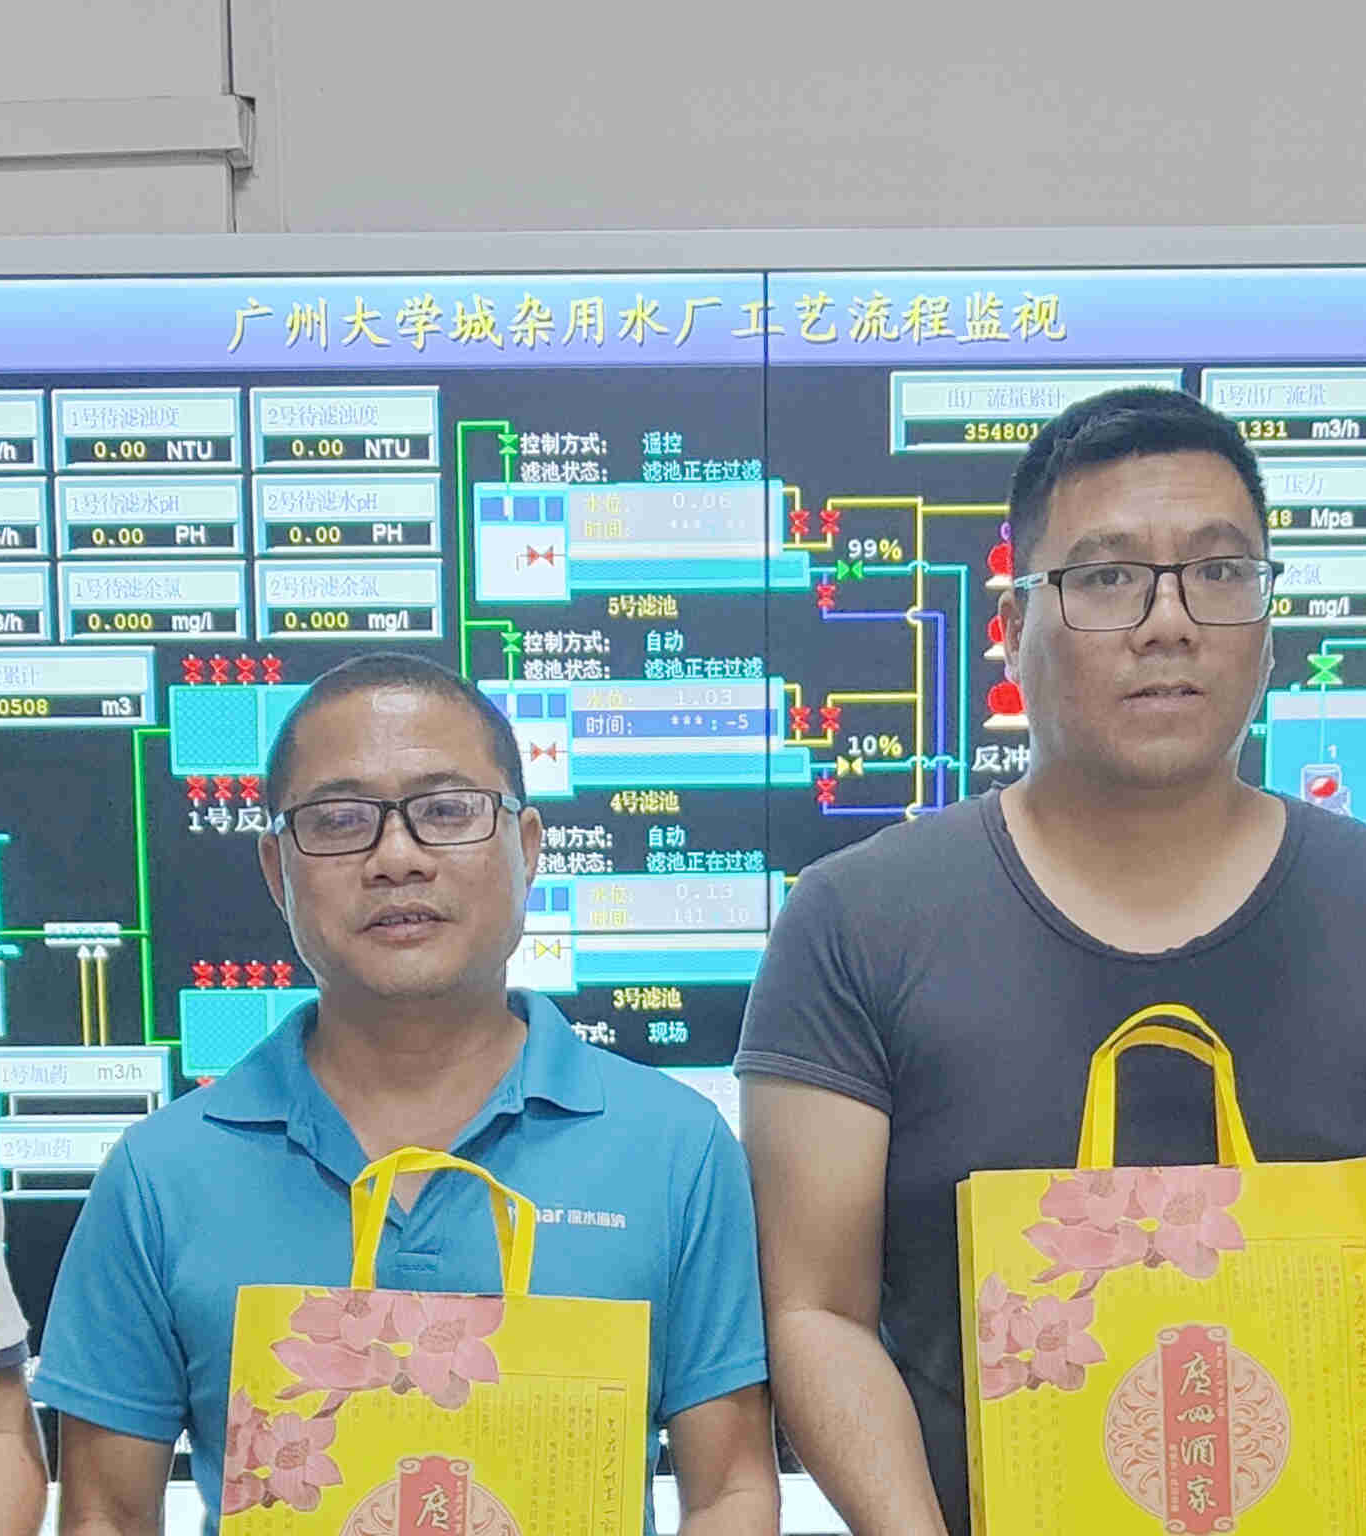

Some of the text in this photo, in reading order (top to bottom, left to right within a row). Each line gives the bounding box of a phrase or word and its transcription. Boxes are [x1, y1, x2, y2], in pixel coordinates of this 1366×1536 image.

[227, 290, 1068, 353] 广州大学城杂用水厂工艺流程监视
[1311, 419, 1360, 439] m3/h
[93, 440, 213, 460] 0.00 NTU
[291, 438, 412, 458] 0.00 NTU
[519, 432, 608, 456] 控制方式:
[520, 459, 763, 483] 滤池状态: 滤池正在过滤
[1310, 508, 1354, 530] Mpa
[91, 525, 206, 545] 0.00 PH
[289, 523, 404, 543] 0.00 PH
[847, 538, 903, 560] 99%
[607, 594, 679, 618] 5号滤池
[1308, 597, 1351, 618] mg/l
[87, 611, 213, 633] 0.000 mg/l
[284, 610, 409, 632] 0.000 mg/l
[523, 630, 684, 653] 控制方式: 自动
[523, 657, 764, 680] 滤池状态: 滤池正在过滤
[100, 697, 133, 716] m3
[586, 715, 634, 736] 时间:
[847, 734, 903, 756] 10%
[1327, 744, 1337, 758] 1
[610, 791, 680, 814] 4号滤池
[187, 806, 273, 834] 1号反
[647, 825, 686, 848] 自动
[645, 850, 765, 872] 滤池正在过滤
[612, 986, 683, 1010] 3号滤池
[647, 1021, 689, 1044] 现场
[97, 1063, 143, 1081] m3/h
